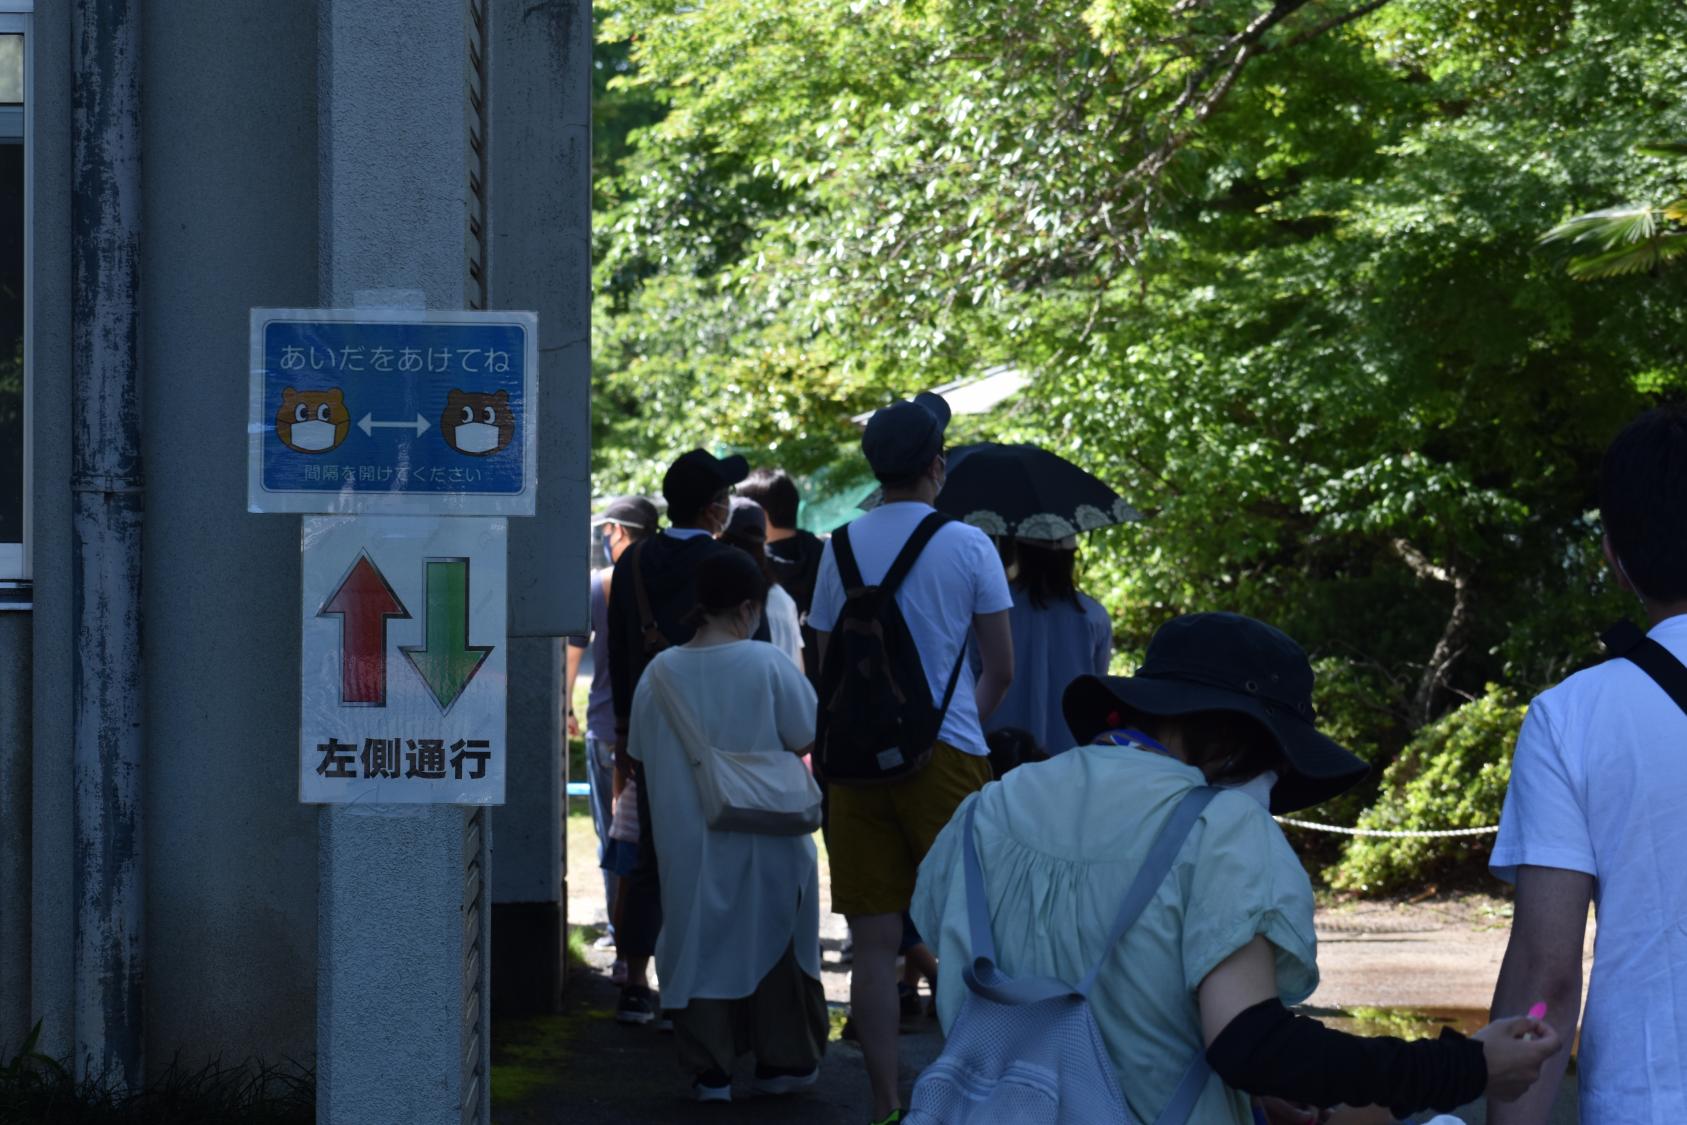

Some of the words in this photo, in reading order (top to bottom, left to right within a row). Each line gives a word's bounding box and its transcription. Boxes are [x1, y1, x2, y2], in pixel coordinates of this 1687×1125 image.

[280, 345, 510, 373] あいだをあけてね
[304, 464, 482, 483] 間隔を開けてください
[316, 737, 491, 780] 左側通行
